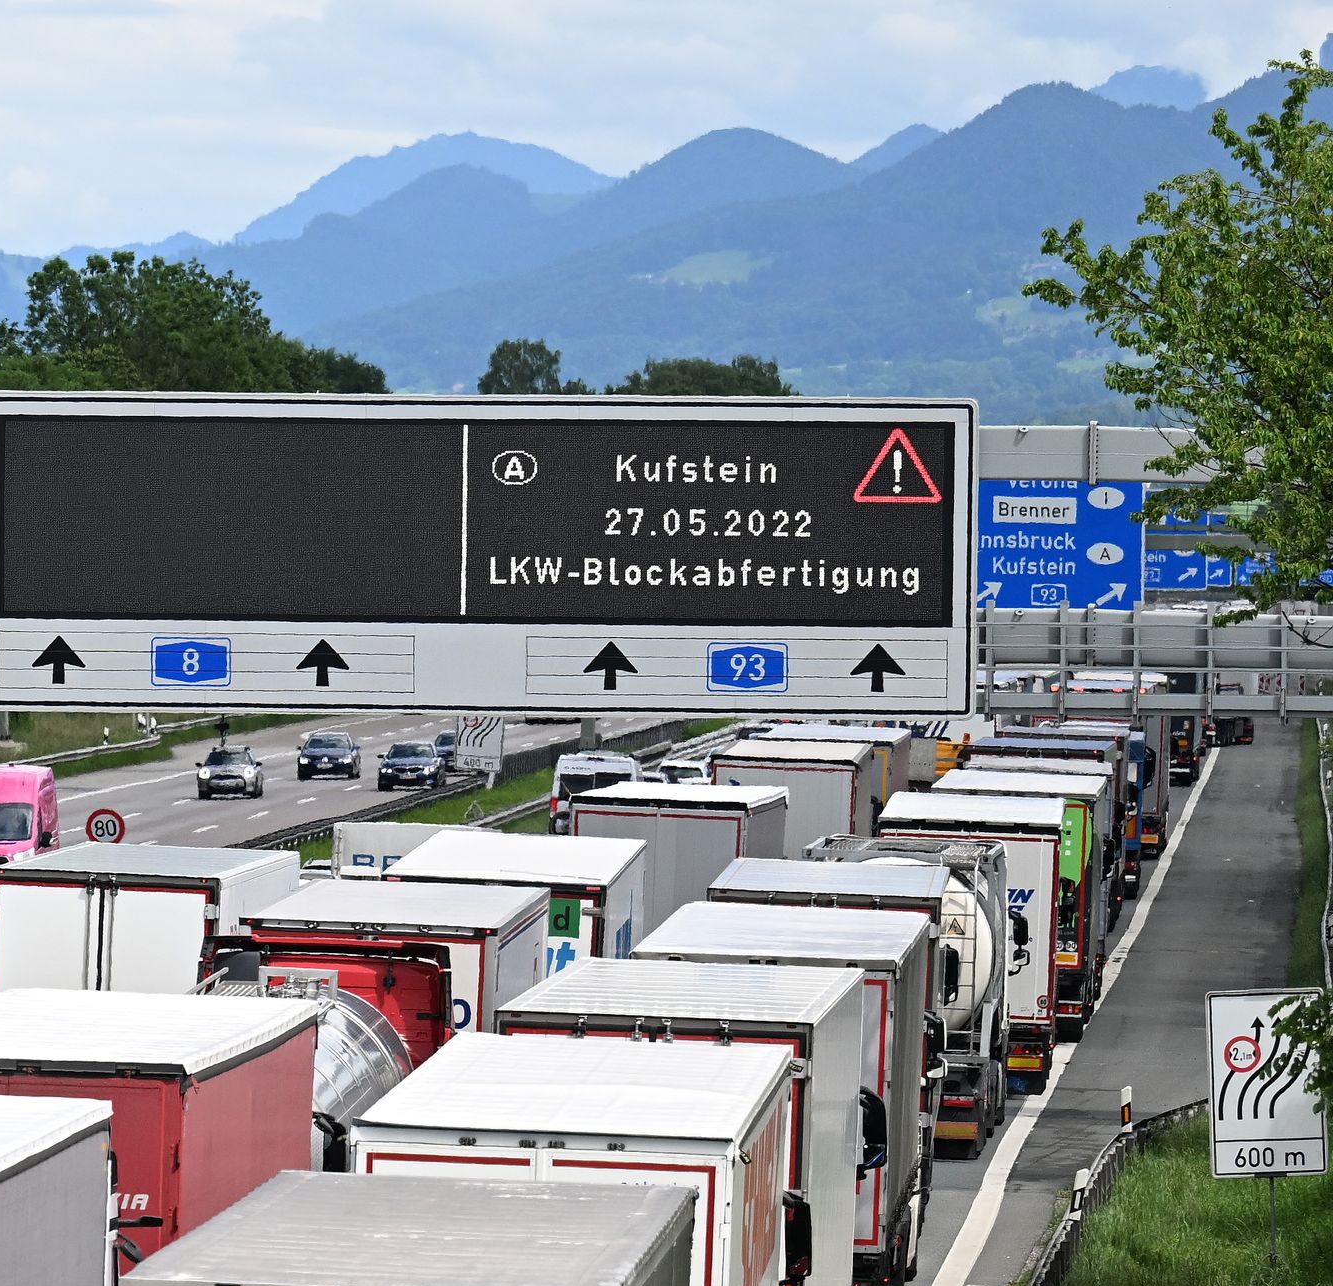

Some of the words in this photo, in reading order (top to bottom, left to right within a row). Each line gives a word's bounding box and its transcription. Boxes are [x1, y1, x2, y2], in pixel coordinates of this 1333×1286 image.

[504, 457, 525, 480] A
[615, 455, 778, 483] Kufstein
[998, 502, 1070, 518] Brenner
[604, 508, 812, 538] 27.05.2022
[980, 531, 1076, 550] nnsbruck
[1099, 547, 1111, 561] A
[489, 556, 920, 595] LKW-Blockabfertigung
[992, 556, 1076, 576] Kufstein
[1040, 588, 1058, 601] 93
[182, 649, 199, 675] 8
[731, 654, 766, 681] 93
[94, 819, 117, 837] 80
[1234, 1147, 1275, 1168] 600
[1285, 1151, 1305, 1167] m
